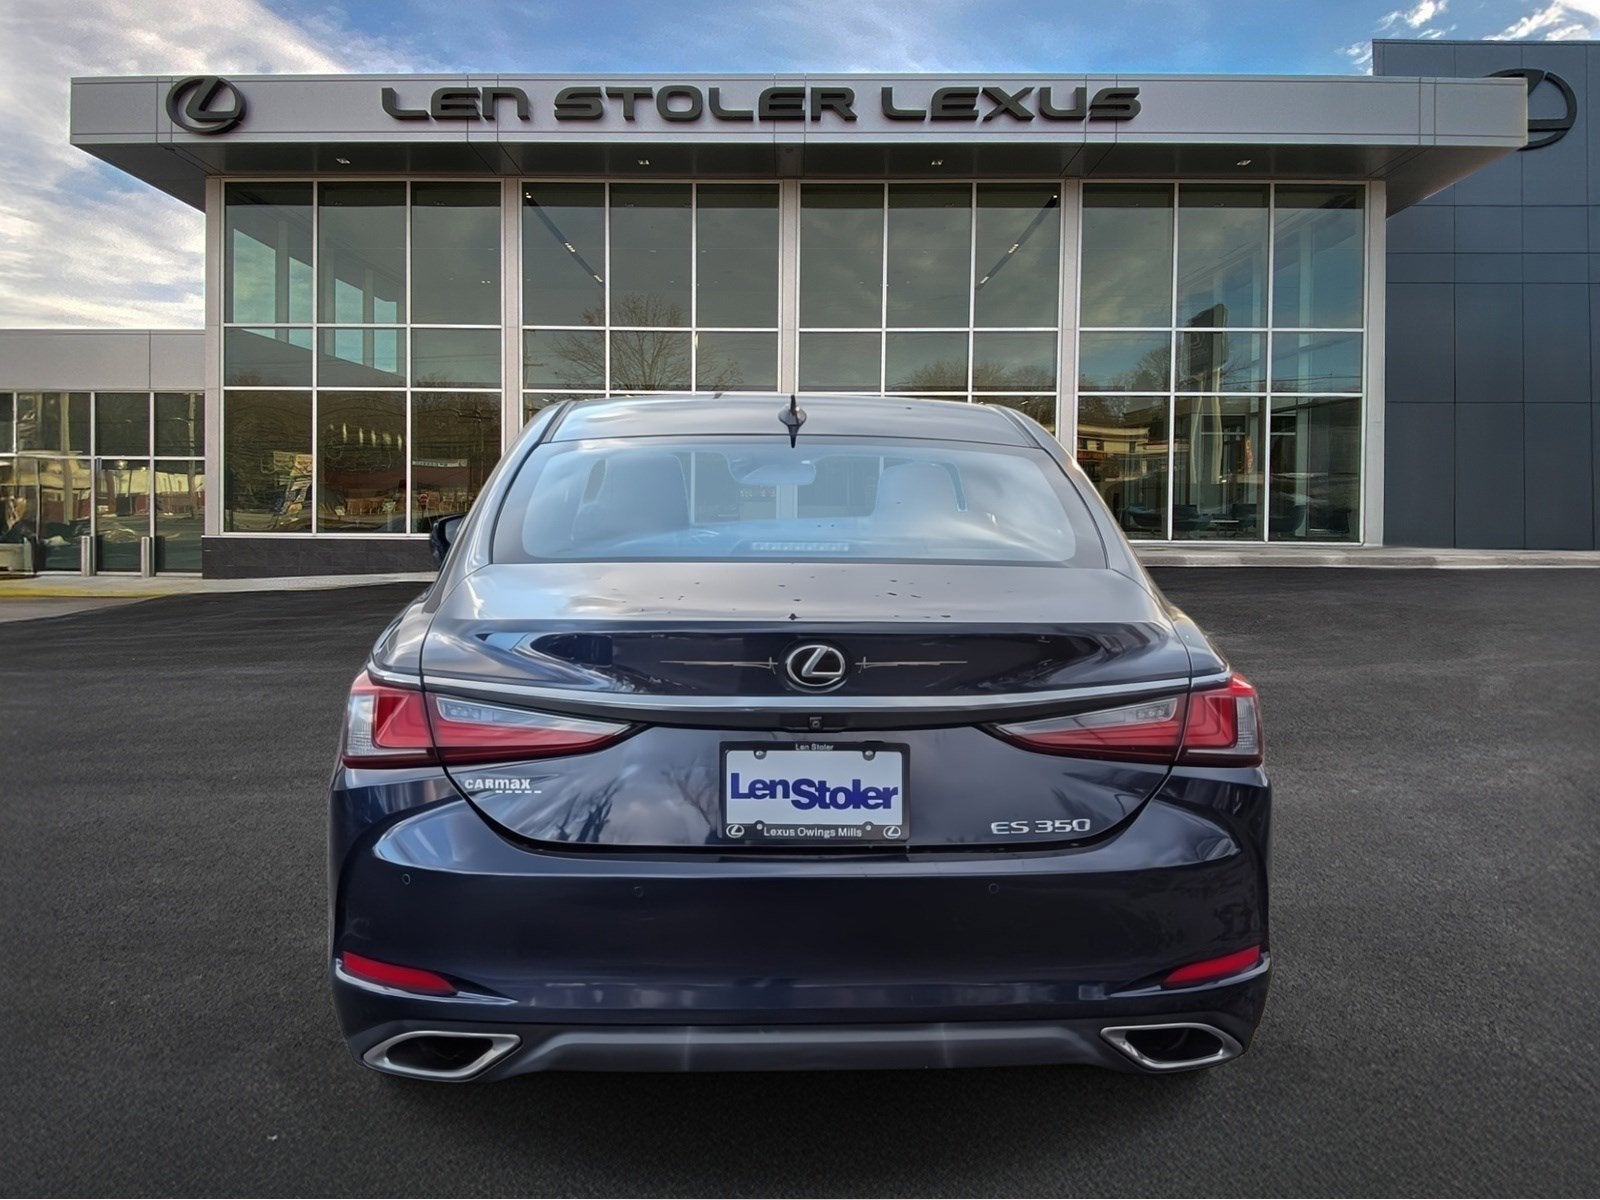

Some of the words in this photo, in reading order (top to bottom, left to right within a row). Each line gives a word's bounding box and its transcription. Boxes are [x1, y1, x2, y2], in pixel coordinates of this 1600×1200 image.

[381, 86, 530, 121] LEN
[554, 85, 858, 122] STOLER
[881, 86, 1142, 122] LEXUS
[795, 743, 810, 751] Len
[811, 743, 834, 751] Stoler
[763, 826, 796, 837] Lexus
[797, 827, 836, 839] Owings
[837, 827, 862, 838] Mills
[990, 821, 1030, 835] ES
[1034, 818, 1091, 833] 350
